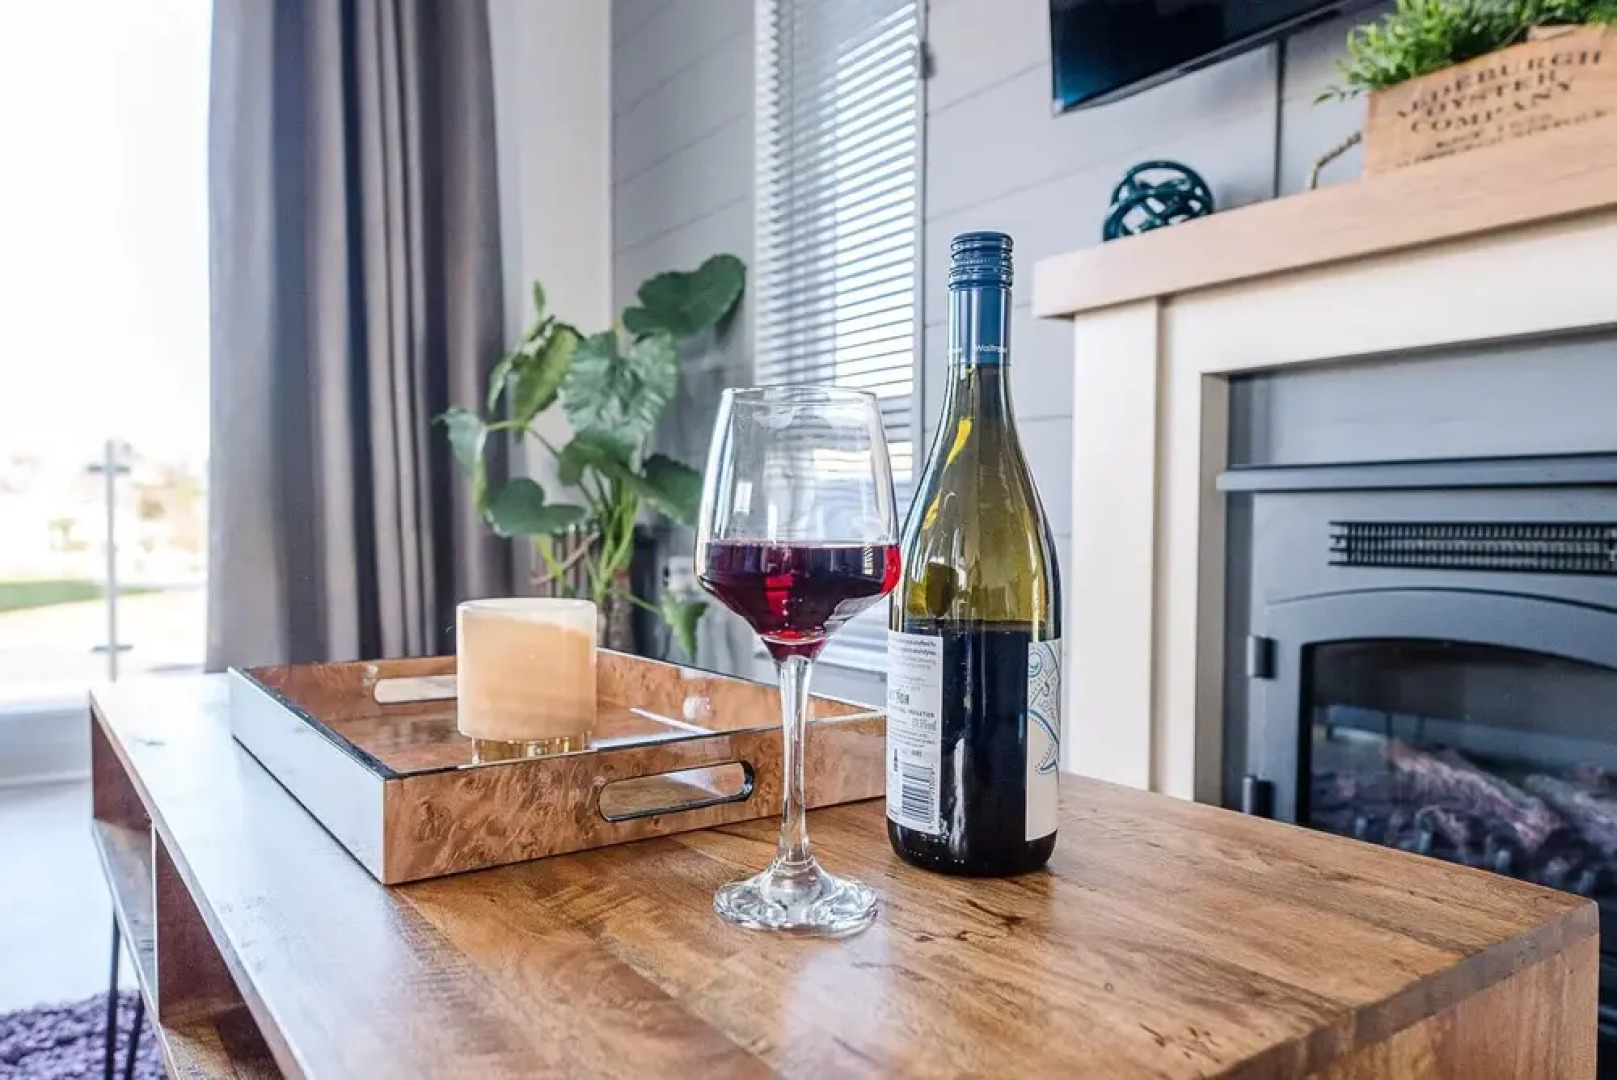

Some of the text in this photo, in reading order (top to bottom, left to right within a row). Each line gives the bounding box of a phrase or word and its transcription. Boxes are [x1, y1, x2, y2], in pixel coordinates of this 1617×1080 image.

[1397, 50, 1602, 118] ALDEBURGH
[1411, 74, 1575, 133] COMPANY
[1426, 69, 1557, 117] OYSTER
